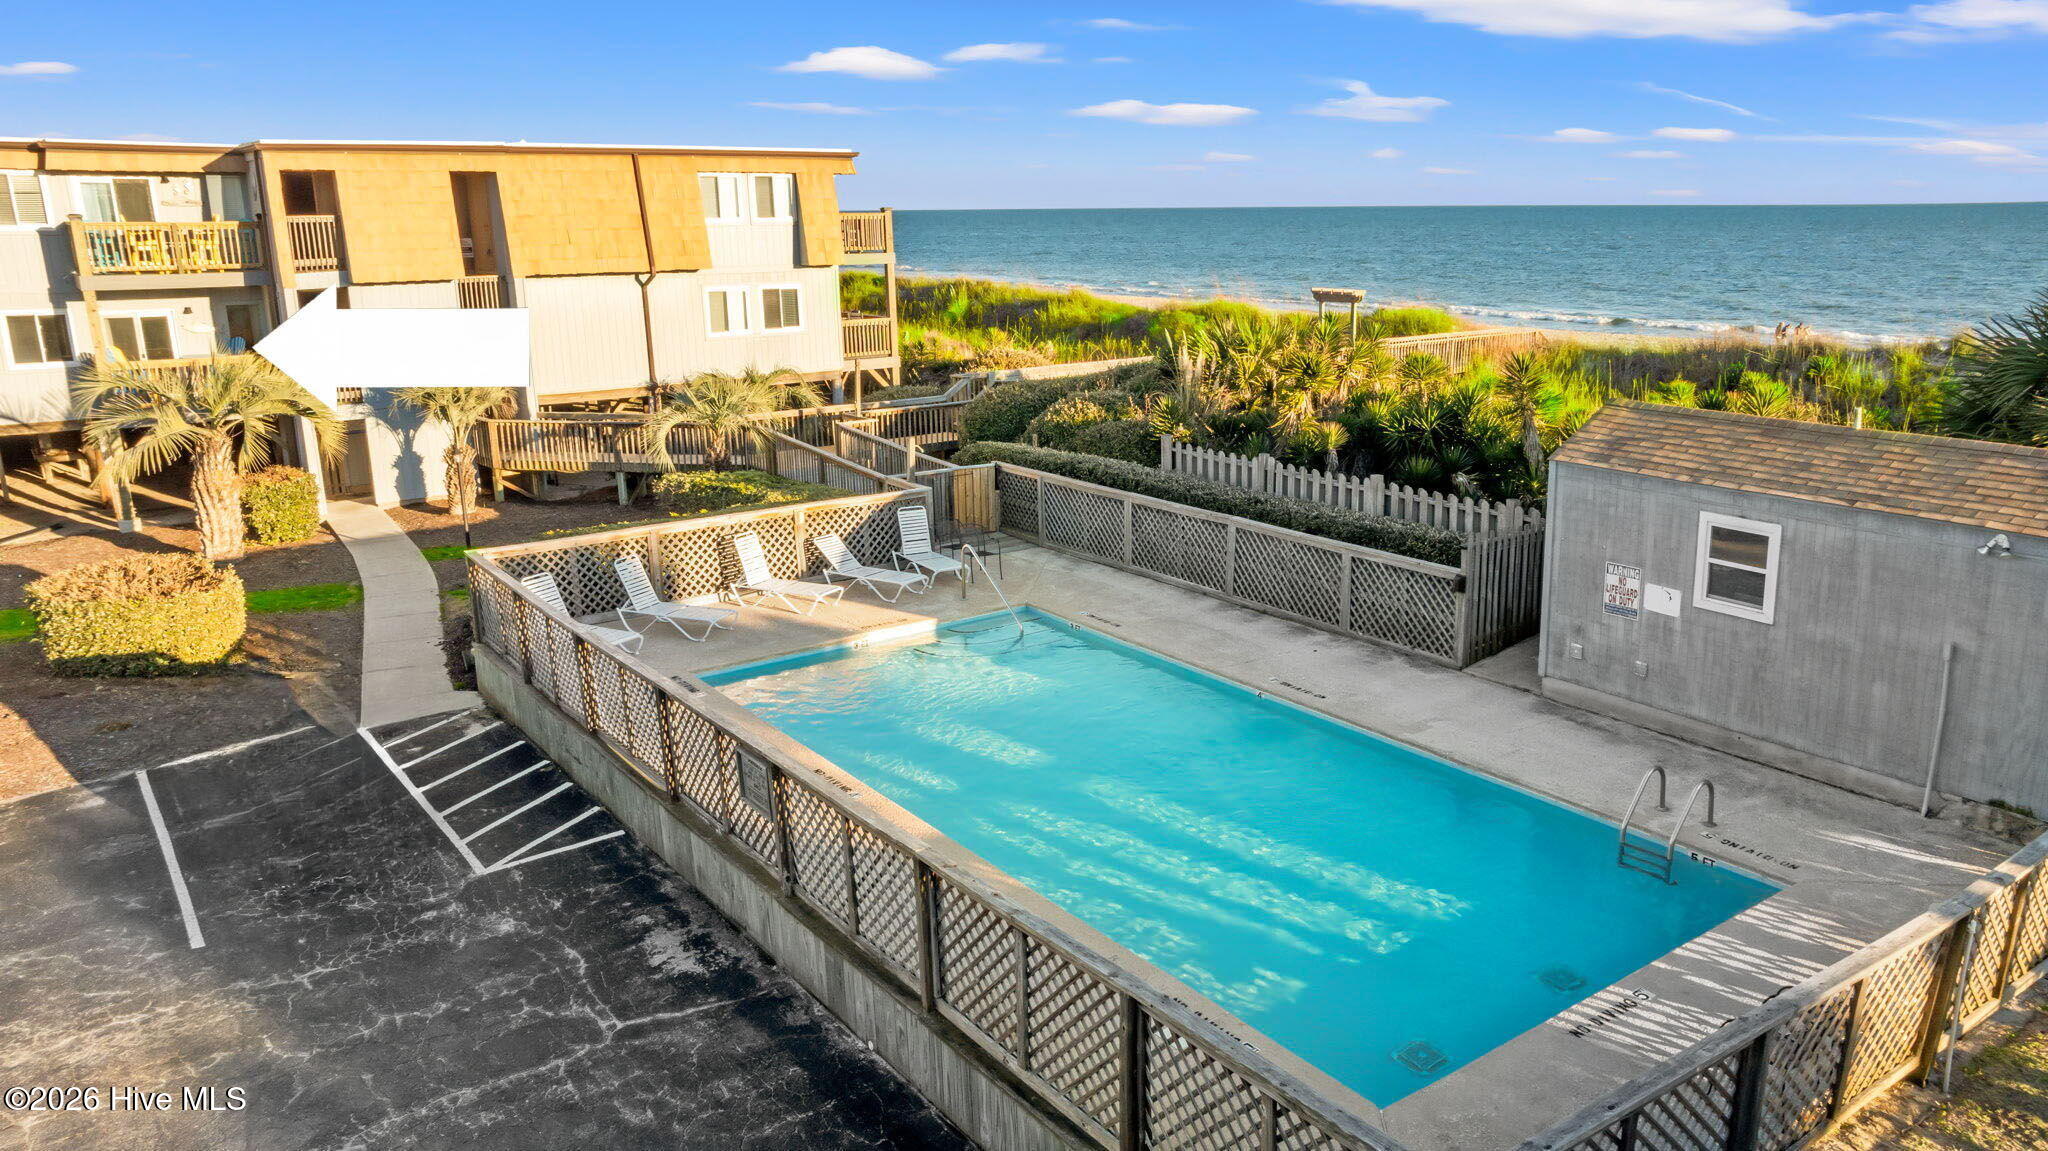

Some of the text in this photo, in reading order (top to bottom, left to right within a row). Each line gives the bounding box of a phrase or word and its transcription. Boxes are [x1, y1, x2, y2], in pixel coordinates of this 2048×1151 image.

[1607, 563, 1640, 580] WARNING
[1618, 577, 1627, 586] NO
[1606, 584, 1638, 599] LIFEGUARD
[1608, 594, 1634, 606] ON DUTY
[1690, 852, 1716, 868] 5 FT
[1632, 988, 1649, 1000] 5
